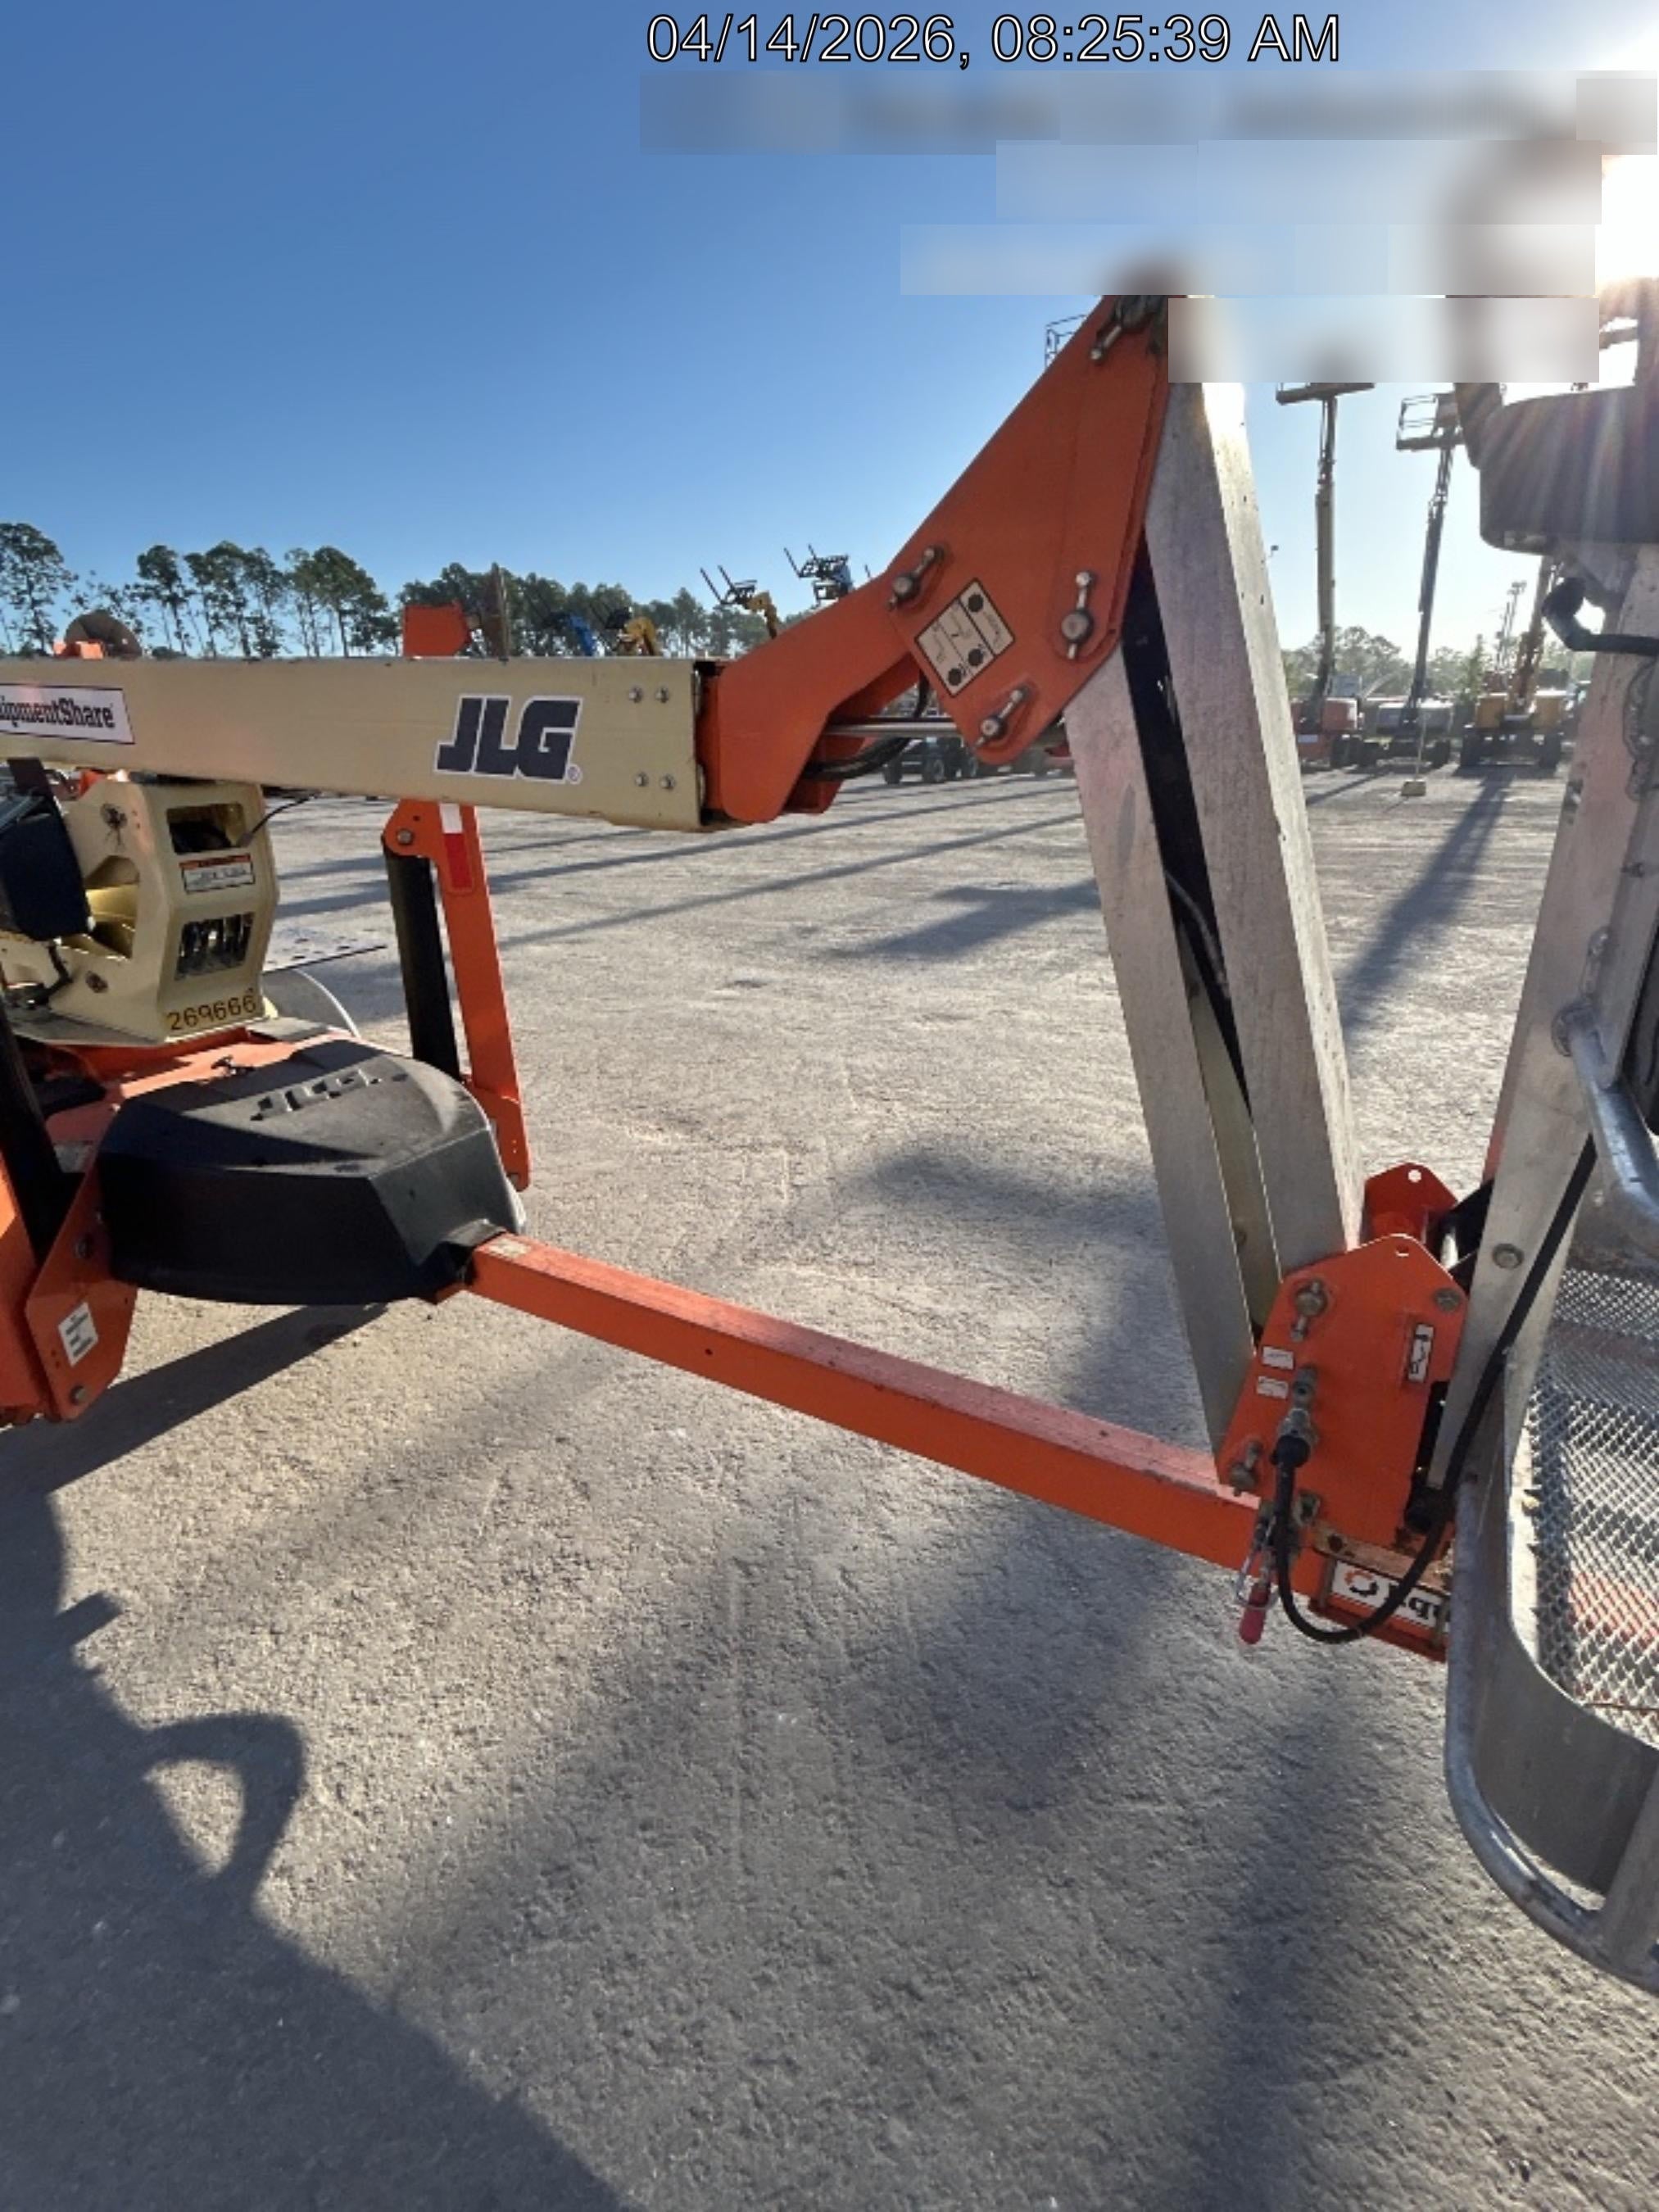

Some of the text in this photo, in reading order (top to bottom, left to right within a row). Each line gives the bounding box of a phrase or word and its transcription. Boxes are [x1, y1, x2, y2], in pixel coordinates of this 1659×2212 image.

[0, 696, 115, 728] ipmentShare
[436, 696, 581, 781] JLG
[166, 995, 256, 1030] 269666
